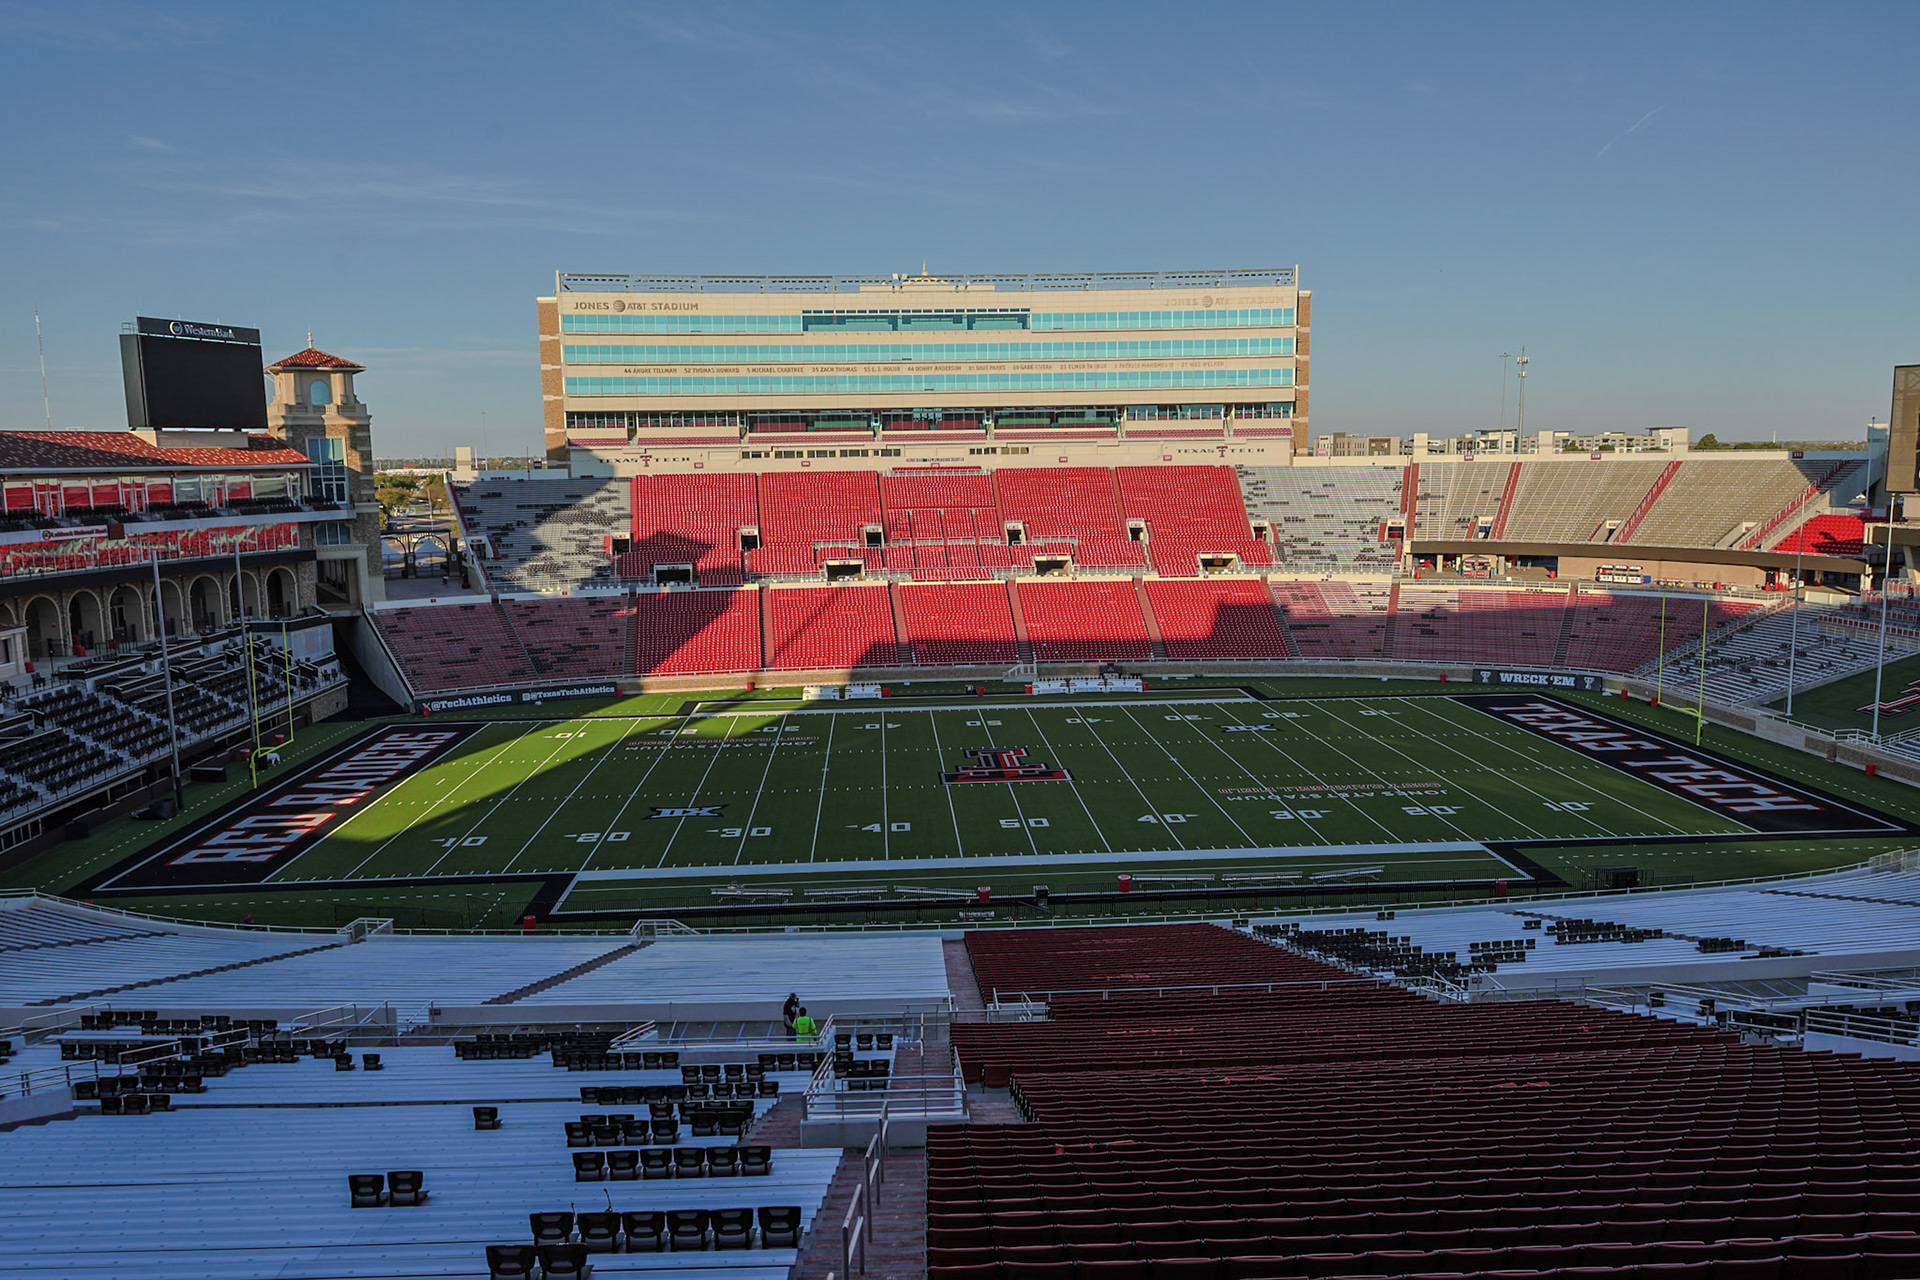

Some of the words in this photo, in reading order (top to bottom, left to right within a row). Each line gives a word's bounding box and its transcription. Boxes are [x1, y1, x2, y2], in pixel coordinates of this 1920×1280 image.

[573, 301, 609, 310] JONES
[627, 302, 647, 310] AT&T
[651, 302, 699, 311] STADIUM
[1164, 297, 1198, 306] JONES
[1499, 672, 1549, 685] WRECK
[530, 686, 615, 701] @TexasTechAthletics
[431, 693, 512, 711] @TechAthletics
[1488, 702, 1665, 752] TEXAS
[1620, 754, 1826, 813] TECH
[165, 812, 337, 867] RED
[266, 731, 459, 806] RAIDERS
[1401, 805, 1457, 816] 20
[1542, 801, 1590, 811] 10
[1137, 813, 1187, 824] 40
[1269, 809, 1323, 820] 30
[861, 822, 911, 833] 40
[999, 817, 1050, 829] 50
[576, 831, 631, 843] 20
[720, 826, 772, 838] 30
[441, 836, 489, 848] 10
